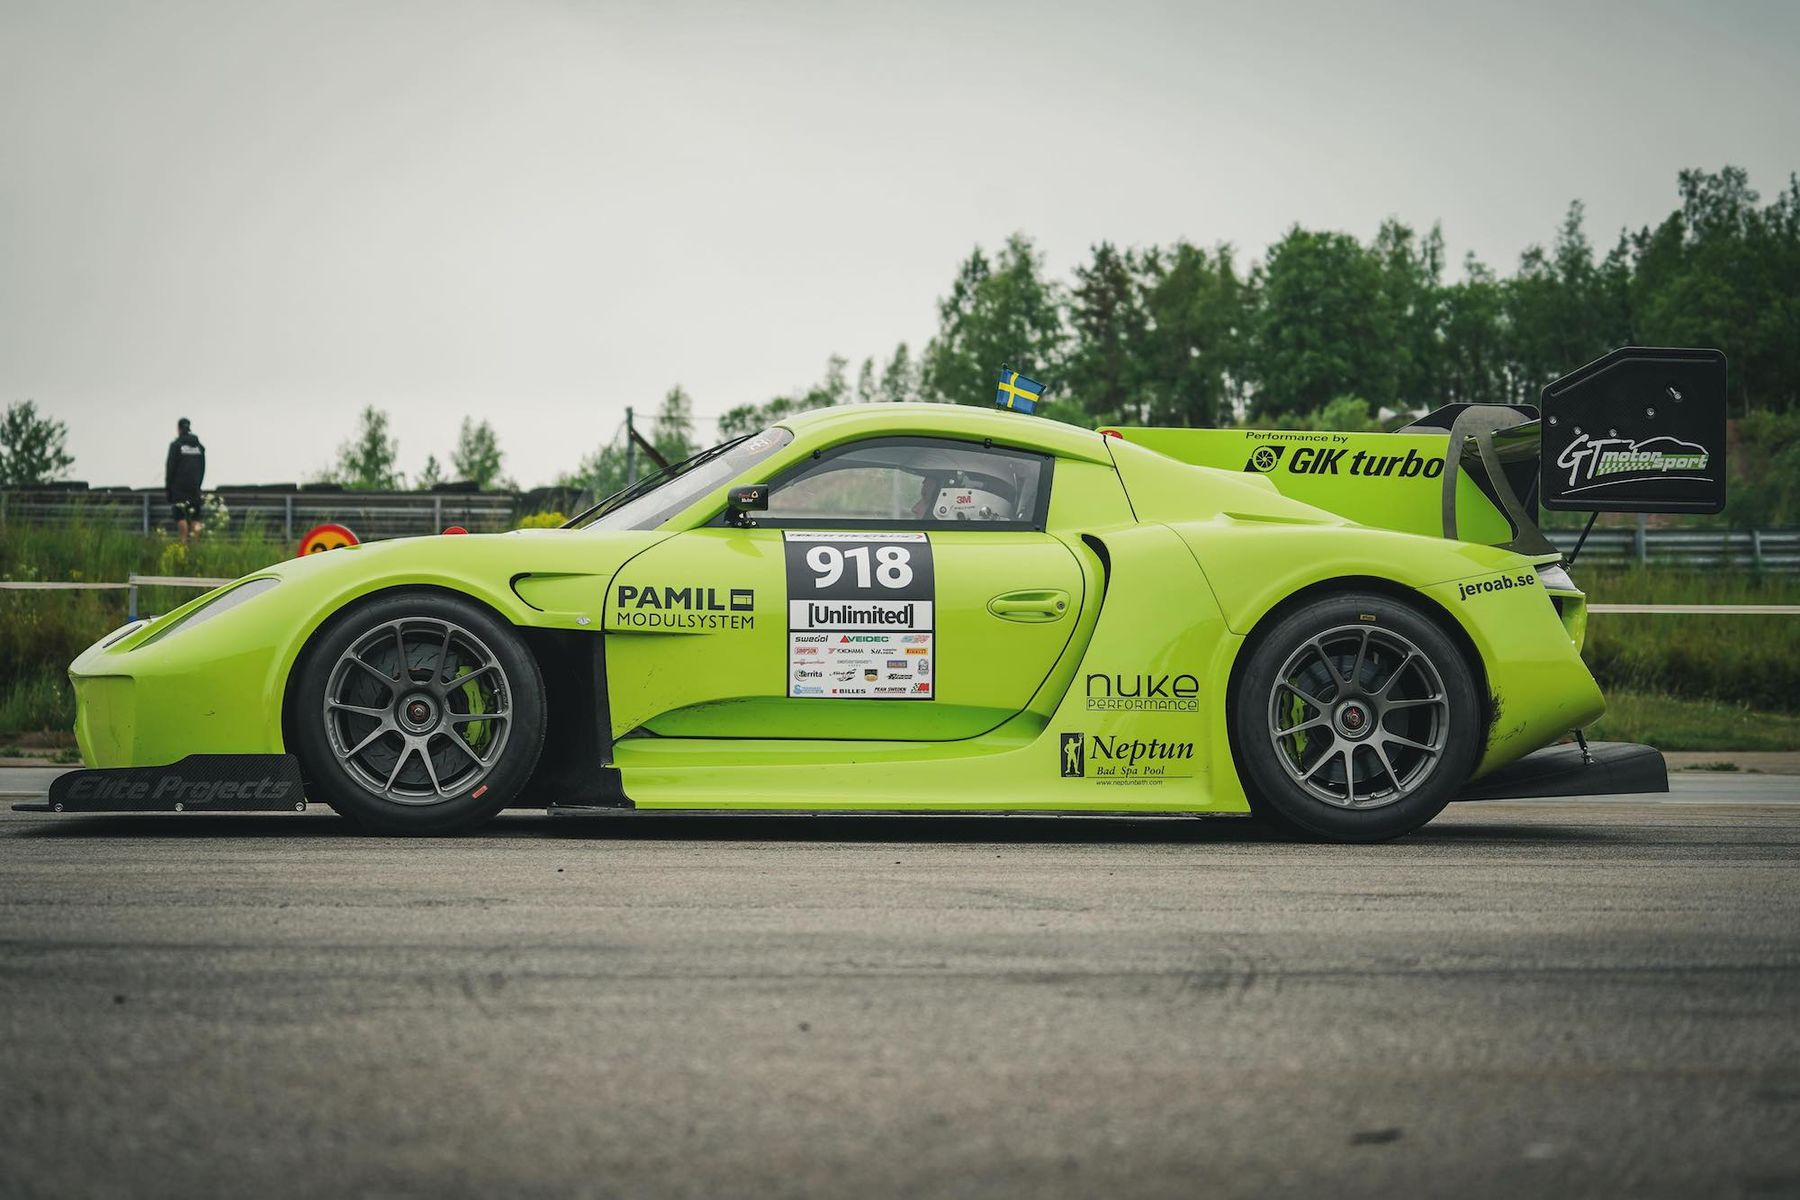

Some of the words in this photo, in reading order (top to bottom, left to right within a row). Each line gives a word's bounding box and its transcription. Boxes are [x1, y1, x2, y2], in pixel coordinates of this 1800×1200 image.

[1246, 432, 1328, 442] Performance
[1333, 434, 1348, 444] by
[1288, 448, 1349, 475] GIK
[1350, 449, 1445, 478] turbo
[1557, 434, 1622, 486] GT
[956, 495, 972, 504] 3M
[806, 546, 913, 589] 918
[618, 586, 725, 611] PAMIL
[1458, 574, 1535, 601] jeroab.se
[617, 612, 754, 629] MODULSYSTEM
[795, 634, 829, 643] swedol
[847, 635, 889, 643] VEIDEC
[1086, 673, 1199, 698] nuke
[1090, 735, 1194, 766] Neptun
[1097, 766, 1116, 775] Bad
[1121, 766, 1138, 778] Spa
[1144, 766, 1165, 775] Pool
[68, 776, 149, 800] Elite
[151, 776, 294, 803] Projects
